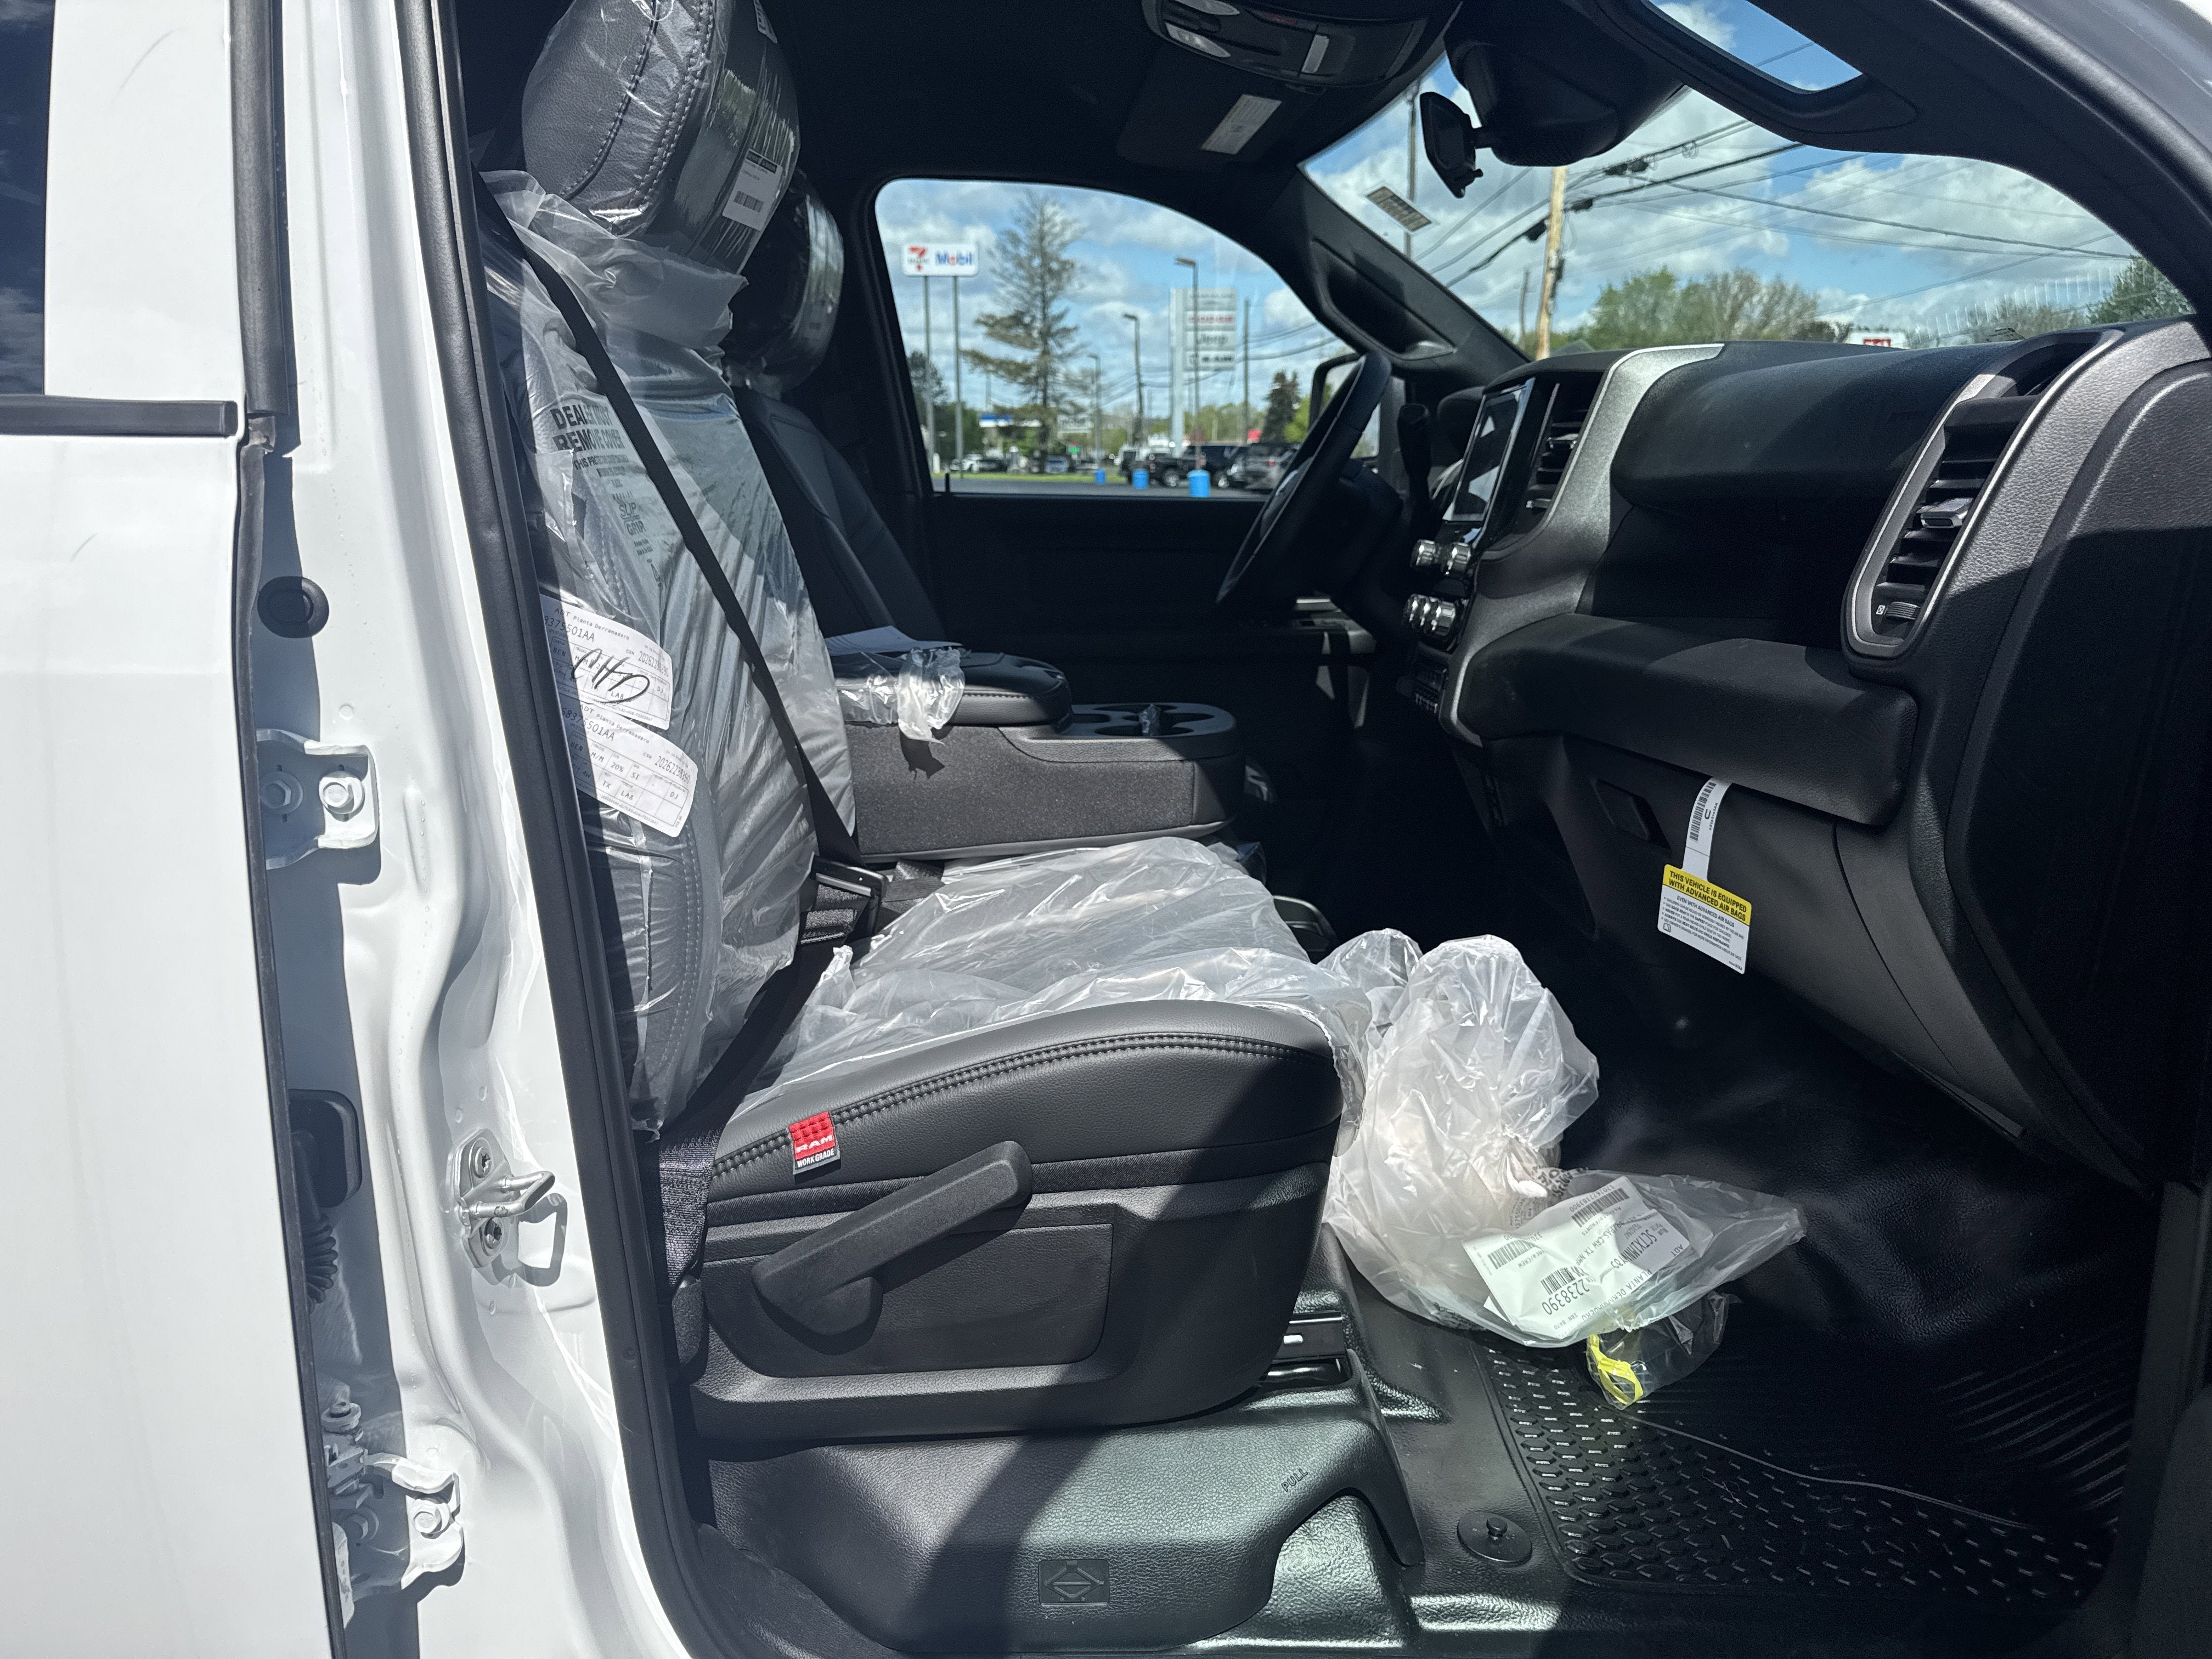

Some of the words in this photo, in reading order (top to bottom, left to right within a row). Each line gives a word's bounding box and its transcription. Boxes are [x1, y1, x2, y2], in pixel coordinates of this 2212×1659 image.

[936, 251, 973, 265] Mobil
[619, 502, 637, 517] SLIP
[554, 608, 571, 617] ADT
[573, 616, 592, 627] Planta
[595, 624, 630, 640] Derramadero
[553, 647, 566, 657] BEN
[574, 656, 589, 664] MM
[596, 713, 614, 726] Planta
[616, 722, 650, 744] Derramadero
[591, 752, 605, 763] M/M
[610, 763, 624, 773] 20%
[654, 755, 690, 785] 20262238390
[602, 780, 612, 789] TX
[620, 790, 634, 800] LA8
[1668, 878, 1685, 891] WITH
[1685, 886, 1719, 907] ADVANCED
[1719, 902, 1730, 912] AIR
[1730, 908, 1746, 922] BAGS
[1669, 870, 1684, 882] THIS
[1685, 876, 1711, 894] VEHICLE
[1711, 889, 1717, 898] IS
[1718, 893, 1747, 913] EQUIPPED
[796, 1135, 833, 1153] RAM
[797, 1155, 815, 1167] WORK
[815, 1148, 834, 1161] GRADE
[1584, 1247, 1594, 1256] TX
[1670, 1244, 1684, 1257] ADT
[1626, 1268, 1652, 1290] PLANTA
[1542, 1279, 1590, 1315] 2238390
[1281, 1468, 1308, 1492] PULL
